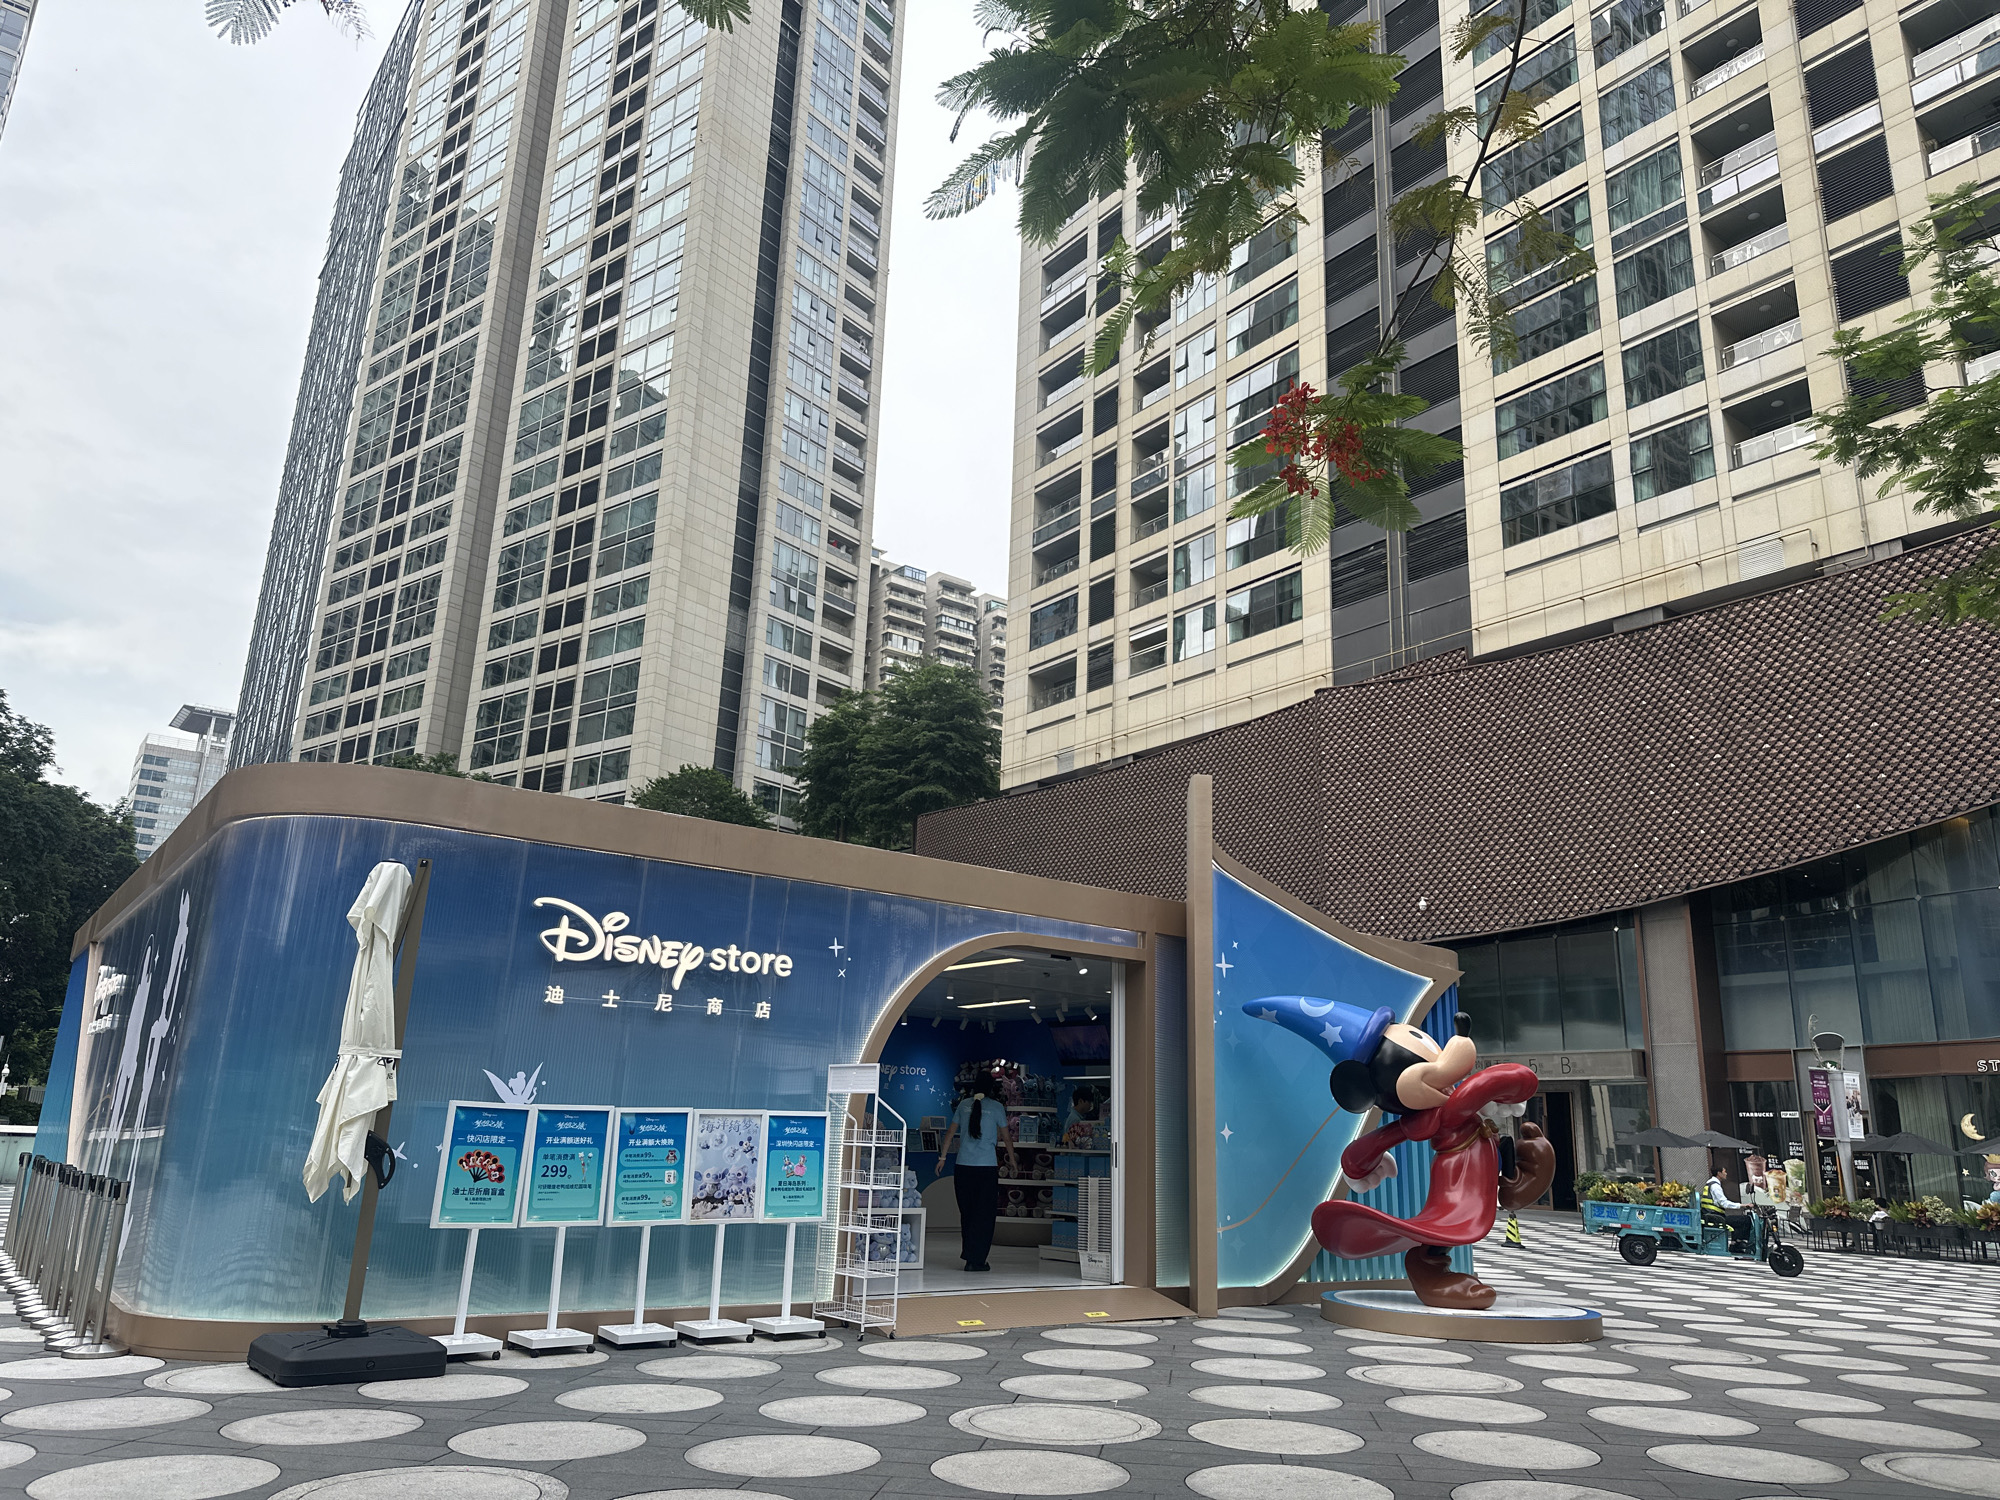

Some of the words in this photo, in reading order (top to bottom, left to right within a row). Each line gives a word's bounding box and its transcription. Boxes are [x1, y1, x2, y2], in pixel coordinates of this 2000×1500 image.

[532, 896, 705, 990] Disney
[708, 943, 794, 978] store
[543, 984, 772, 1020] 迪士尼商店
[899, 1064, 927, 1076] store
[1528, 1058, 1538, 1074] 5
[1560, 1056, 1572, 1074] B
[1976, 1059, 2000, 1073] ST
[466, 1133, 506, 1144] 快闪店限定
[545, 1136, 594, 1145] 开业满额送好礼
[628, 1138, 675, 1147] 开业满额大换购
[775, 1139, 815, 1148] 深圳快闪店限定
[542, 1153, 576, 1161] 单笔消费满
[451, 1187, 506, 1196] 迪士尼折扇盲盒
